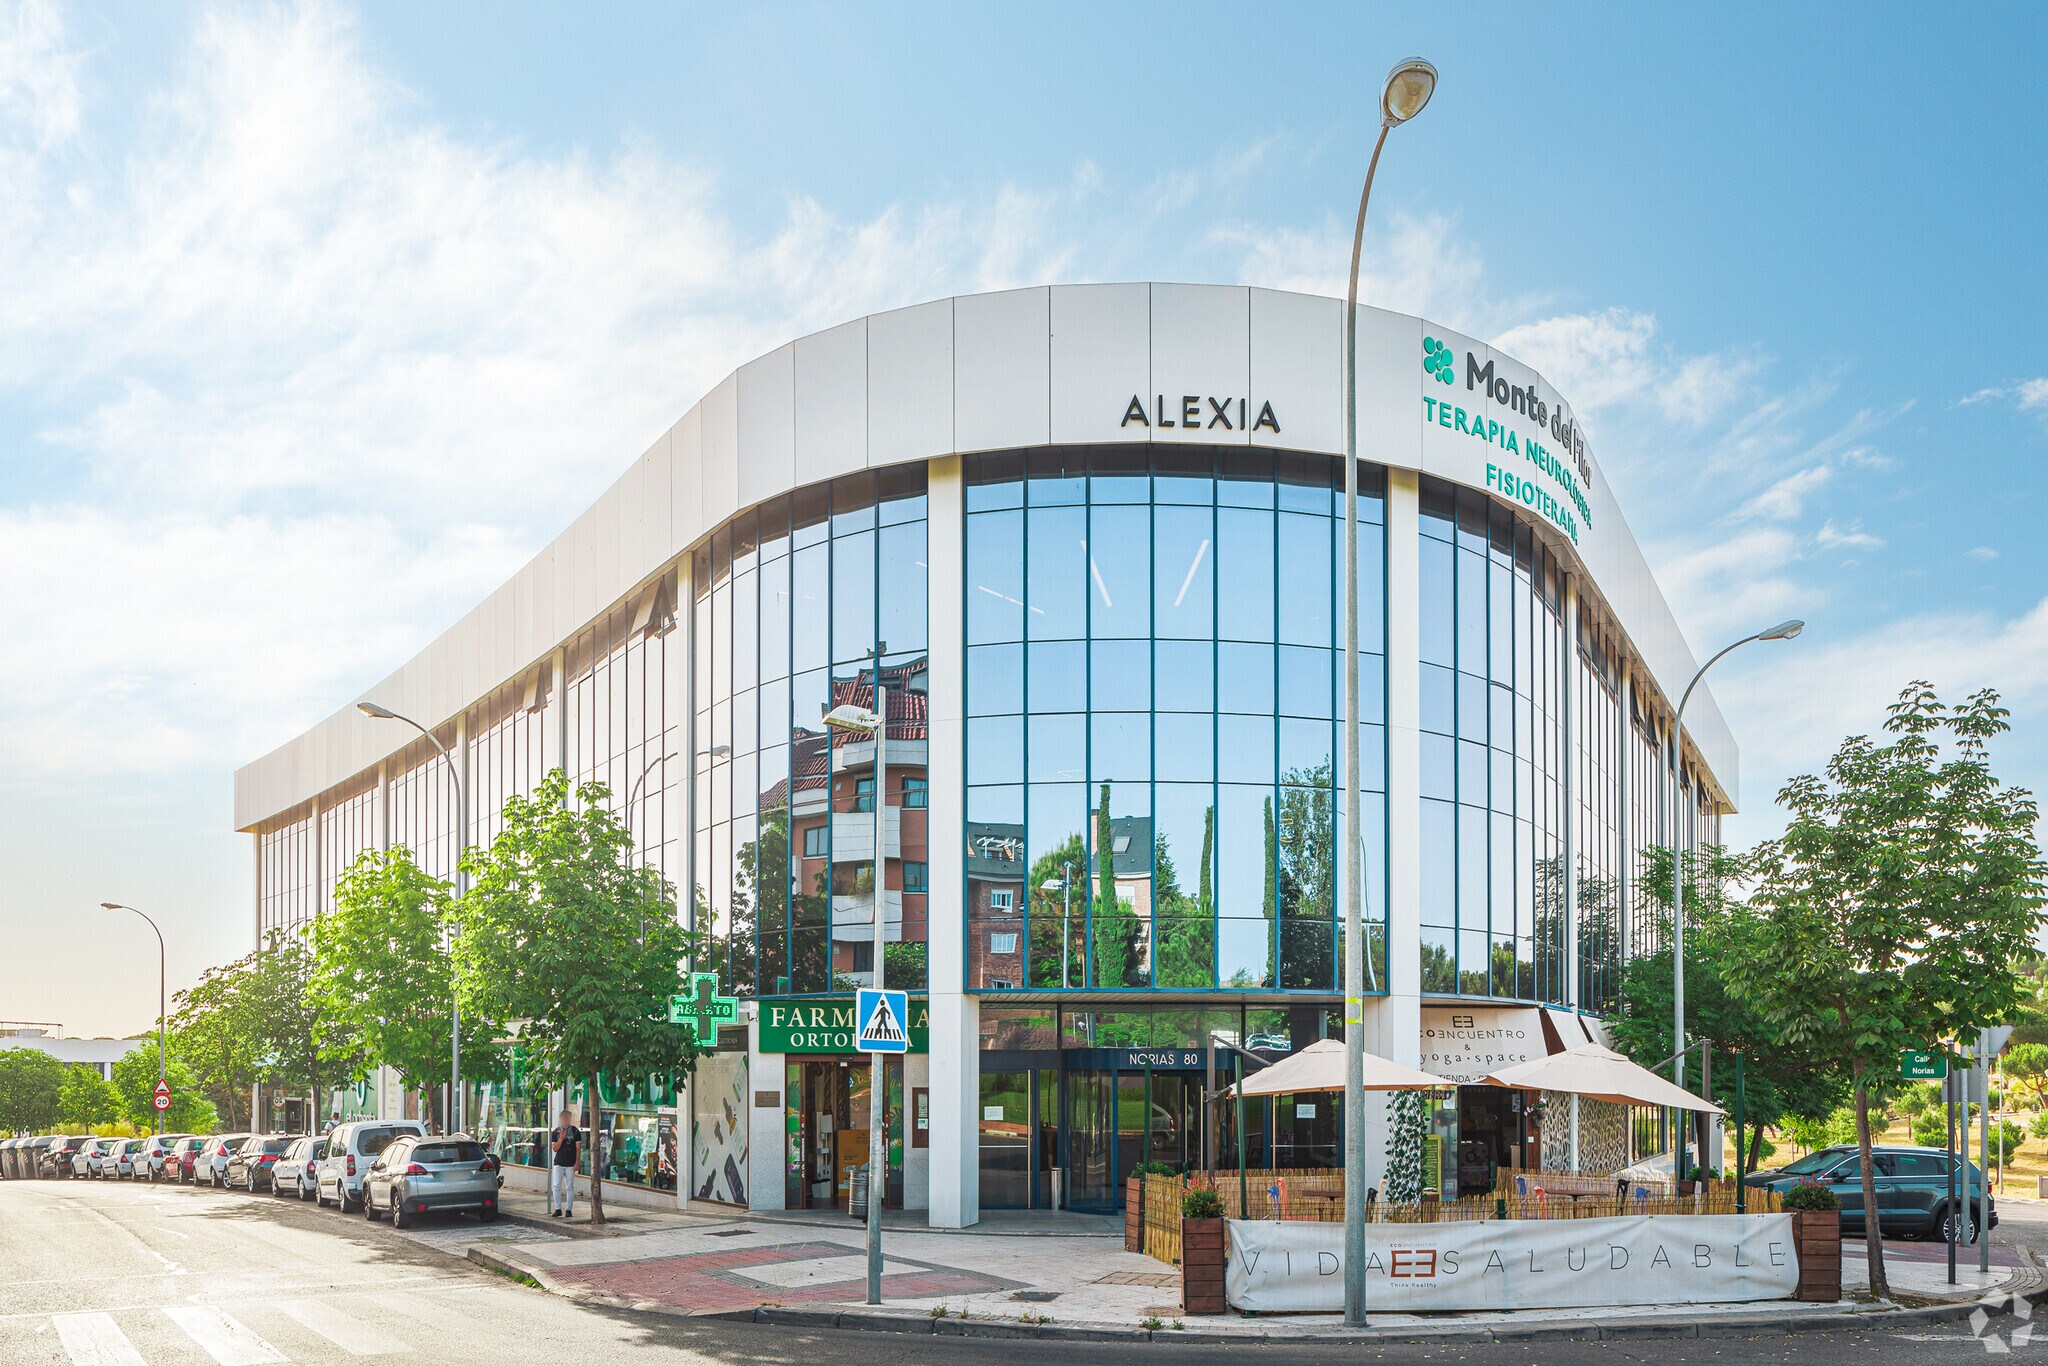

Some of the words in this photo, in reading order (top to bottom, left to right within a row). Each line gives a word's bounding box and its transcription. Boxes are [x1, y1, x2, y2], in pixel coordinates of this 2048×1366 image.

[1121, 394, 1281, 434] ALEXIA
[1467, 351, 1548, 428] Monte
[1551, 404, 1573, 456] del
[1423, 396, 1520, 456] TERAPIA
[770, 1007, 930, 1028] FARMA
[1129, 1053, 1175, 1065] NORIAS
[1184, 1053, 1198, 1065] 80
[1912, 1067, 1935, 1075] Norias
[1240, 1249, 1385, 1276] VIDA
[1442, 1241, 1785, 1276] SALUDABLE
